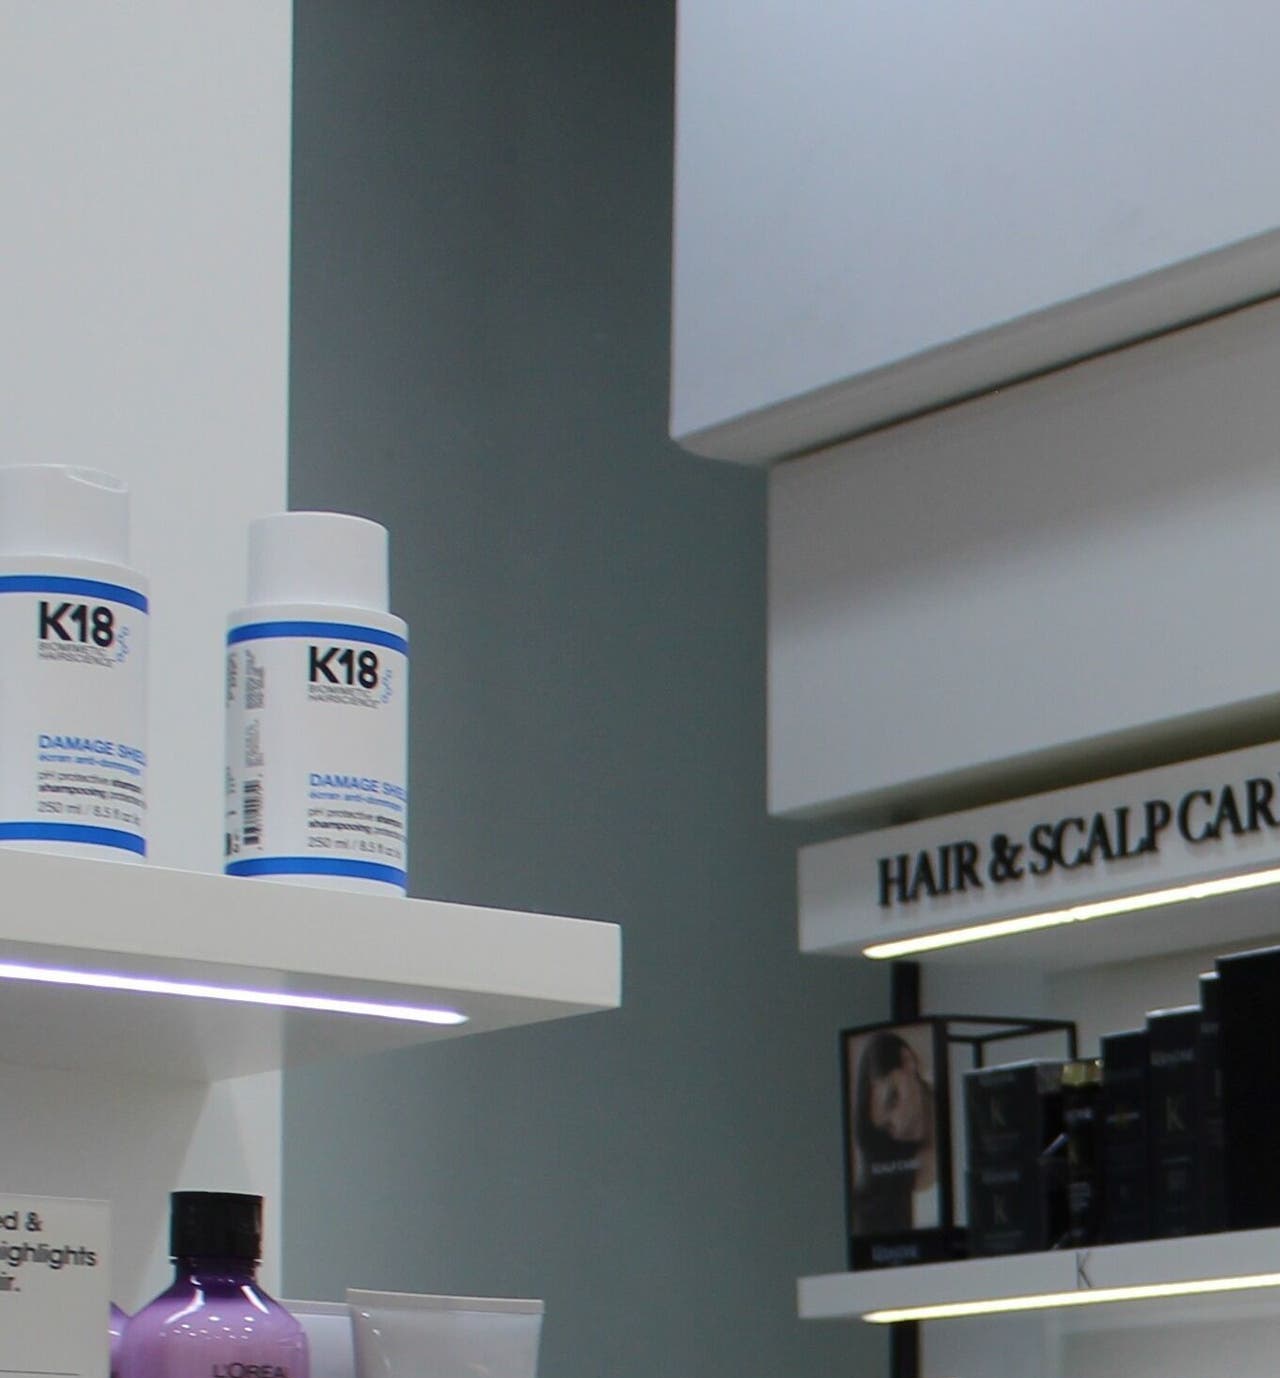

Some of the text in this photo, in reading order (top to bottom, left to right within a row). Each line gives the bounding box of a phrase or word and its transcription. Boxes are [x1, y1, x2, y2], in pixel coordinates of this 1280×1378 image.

[38, 601, 115, 648] K18
[309, 645, 379, 690] K18
[38, 734, 115, 757] DAMAGE
[308, 772, 379, 794] DAMAGE
[877, 840, 985, 907] HAIR
[988, 833, 1023, 883] &
[1029, 800, 1172, 874] SCALP
[25, 1211, 42, 1232] &
[0, 1242, 97, 1269] ighlights
[1076, 1250, 1093, 1289] K
